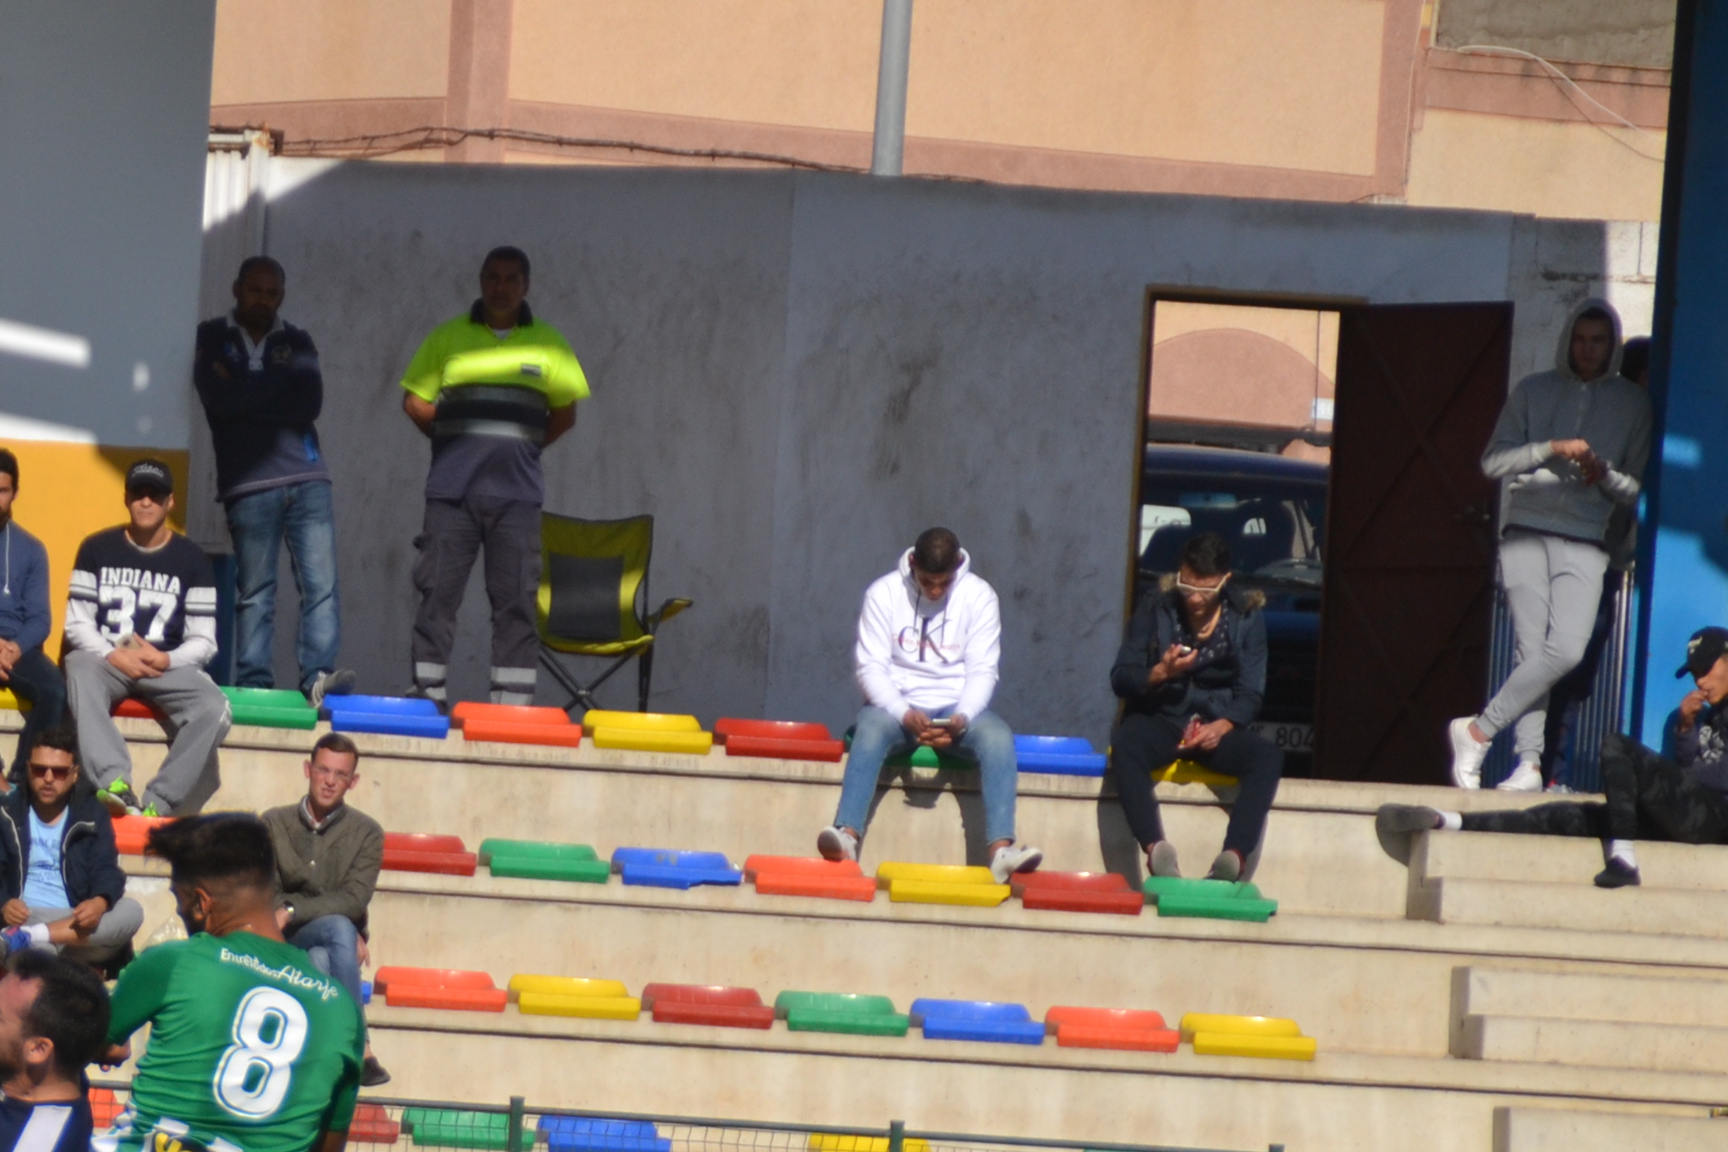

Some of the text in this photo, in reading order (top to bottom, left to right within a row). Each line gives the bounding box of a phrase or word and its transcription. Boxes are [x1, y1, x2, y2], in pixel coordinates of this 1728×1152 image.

[100, 566, 181, 596] INDIANA
[99, 585, 178, 642] 37
[213, 986, 308, 1118] 8
